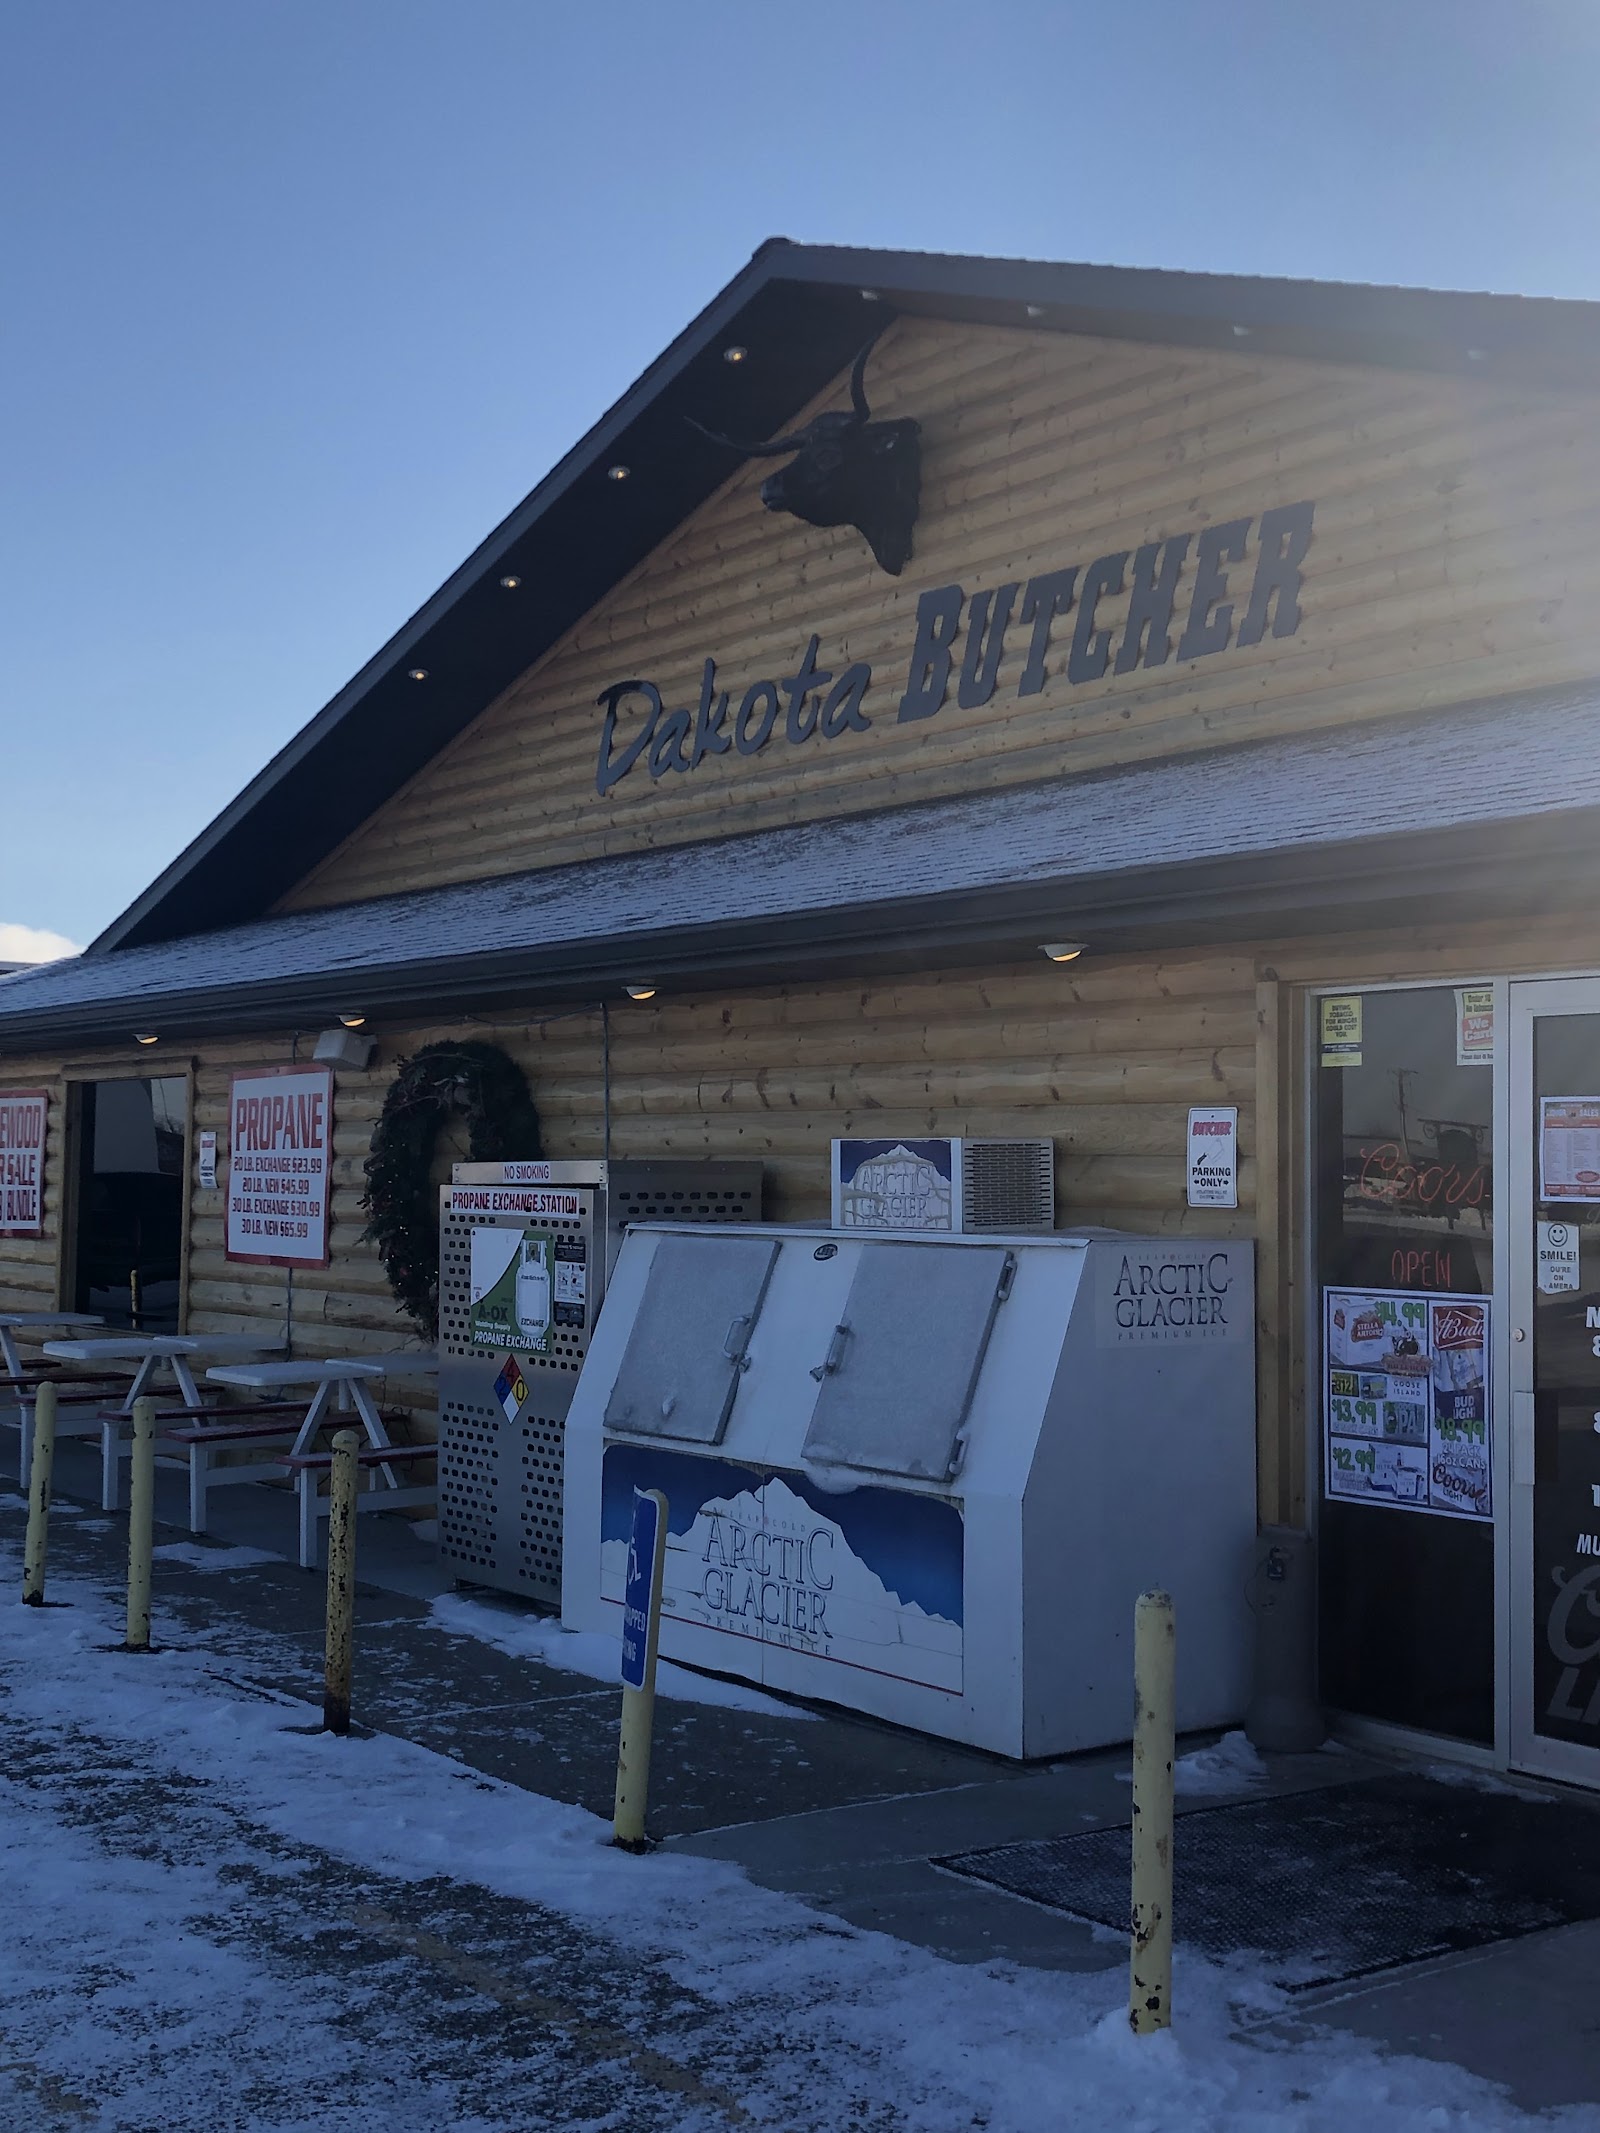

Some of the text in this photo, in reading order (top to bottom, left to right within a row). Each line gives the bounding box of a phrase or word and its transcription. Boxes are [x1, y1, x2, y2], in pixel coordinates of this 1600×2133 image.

[596, 500, 1316, 797] Dakota BUTCHER
[1468, 1017, 1489, 1029] We
[236, 1093, 323, 1151] PROPANE
[8, 1154, 36, 1185] SALE
[234, 1156, 243, 1172] 20
[255, 1157, 291, 1173] EXCHANGE
[292, 1157, 322, 1173] $23.99
[505, 1164, 550, 1180] NO SMOKING
[1192, 1167, 1231, 1177] PARKING
[1360, 1143, 1486, 1205] Coors
[243, 1177, 252, 1192] 20
[265, 1178, 279, 1193] NEW
[281, 1179, 309, 1195] $45.99
[862, 1166, 930, 1196] ARCTIC
[1200, 1178, 1223, 1187] ONLY
[232, 1197, 242, 1213] 30
[254, 1199, 290, 1215] EXCHANGE
[291, 1200, 320, 1217] $30.99
[453, 1192, 577, 1214] PROPANE EXCHANGE STATION
[241, 1218, 251, 1234] 30
[264, 1220, 279, 1236] NEW
[280, 1221, 308, 1238] $65.99
[1540, 1250, 1577, 1261] SMILE!
[1113, 1253, 1229, 1296] ARCTIC
[1391, 1250, 1451, 1288] OPEN
[478, 1303, 508, 1321] A-OX
[1115, 1297, 1229, 1328] GLACIER
[520, 1318, 545, 1327] EXCHANGE
[1356, 1321, 1379, 1330] STELLA
[474, 1330, 547, 1351] PROPANE EXCHANGE
[1118, 1329, 1227, 1341] PREMIUM ICE
[516, 1379, 525, 1402] 0
[1393, 1380, 1420, 1389] GOOSE
[1393, 1388, 1421, 1397] ISLAND
[1454, 1396, 1474, 1407] BUD
[1332, 1399, 1377, 1425] $13.99
[1435, 1417, 1485, 1445] $18.99
[1457, 1444, 1481, 1457] PACK
[1459, 1456, 1486, 1469] CANS
[1443, 1487, 1463, 1503] LIGHT
[702, 1508, 834, 1591] ARCTIC
[702, 1567, 834, 1639] GLACIER
[706, 1615, 832, 1656] PREMIUM ICE
